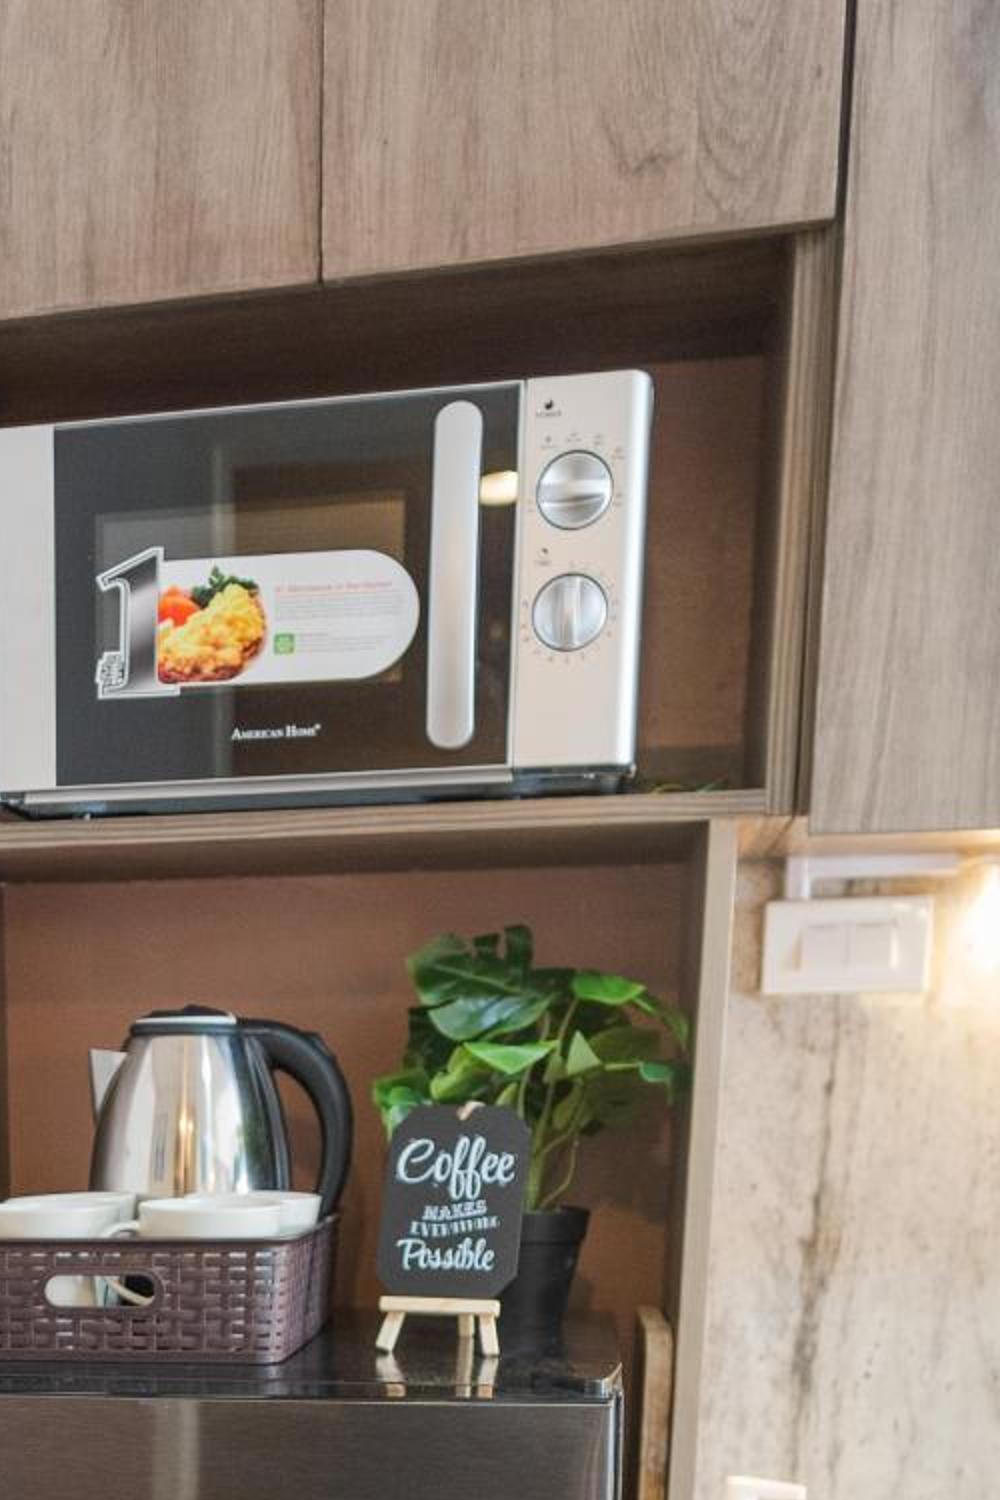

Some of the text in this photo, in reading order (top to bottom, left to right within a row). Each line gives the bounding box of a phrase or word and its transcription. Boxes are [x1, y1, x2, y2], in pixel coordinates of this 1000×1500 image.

[396, 1135, 516, 1201] Coffee
[422, 1200, 488, 1220] MAKES
[395, 1237, 496, 1272] Possible
